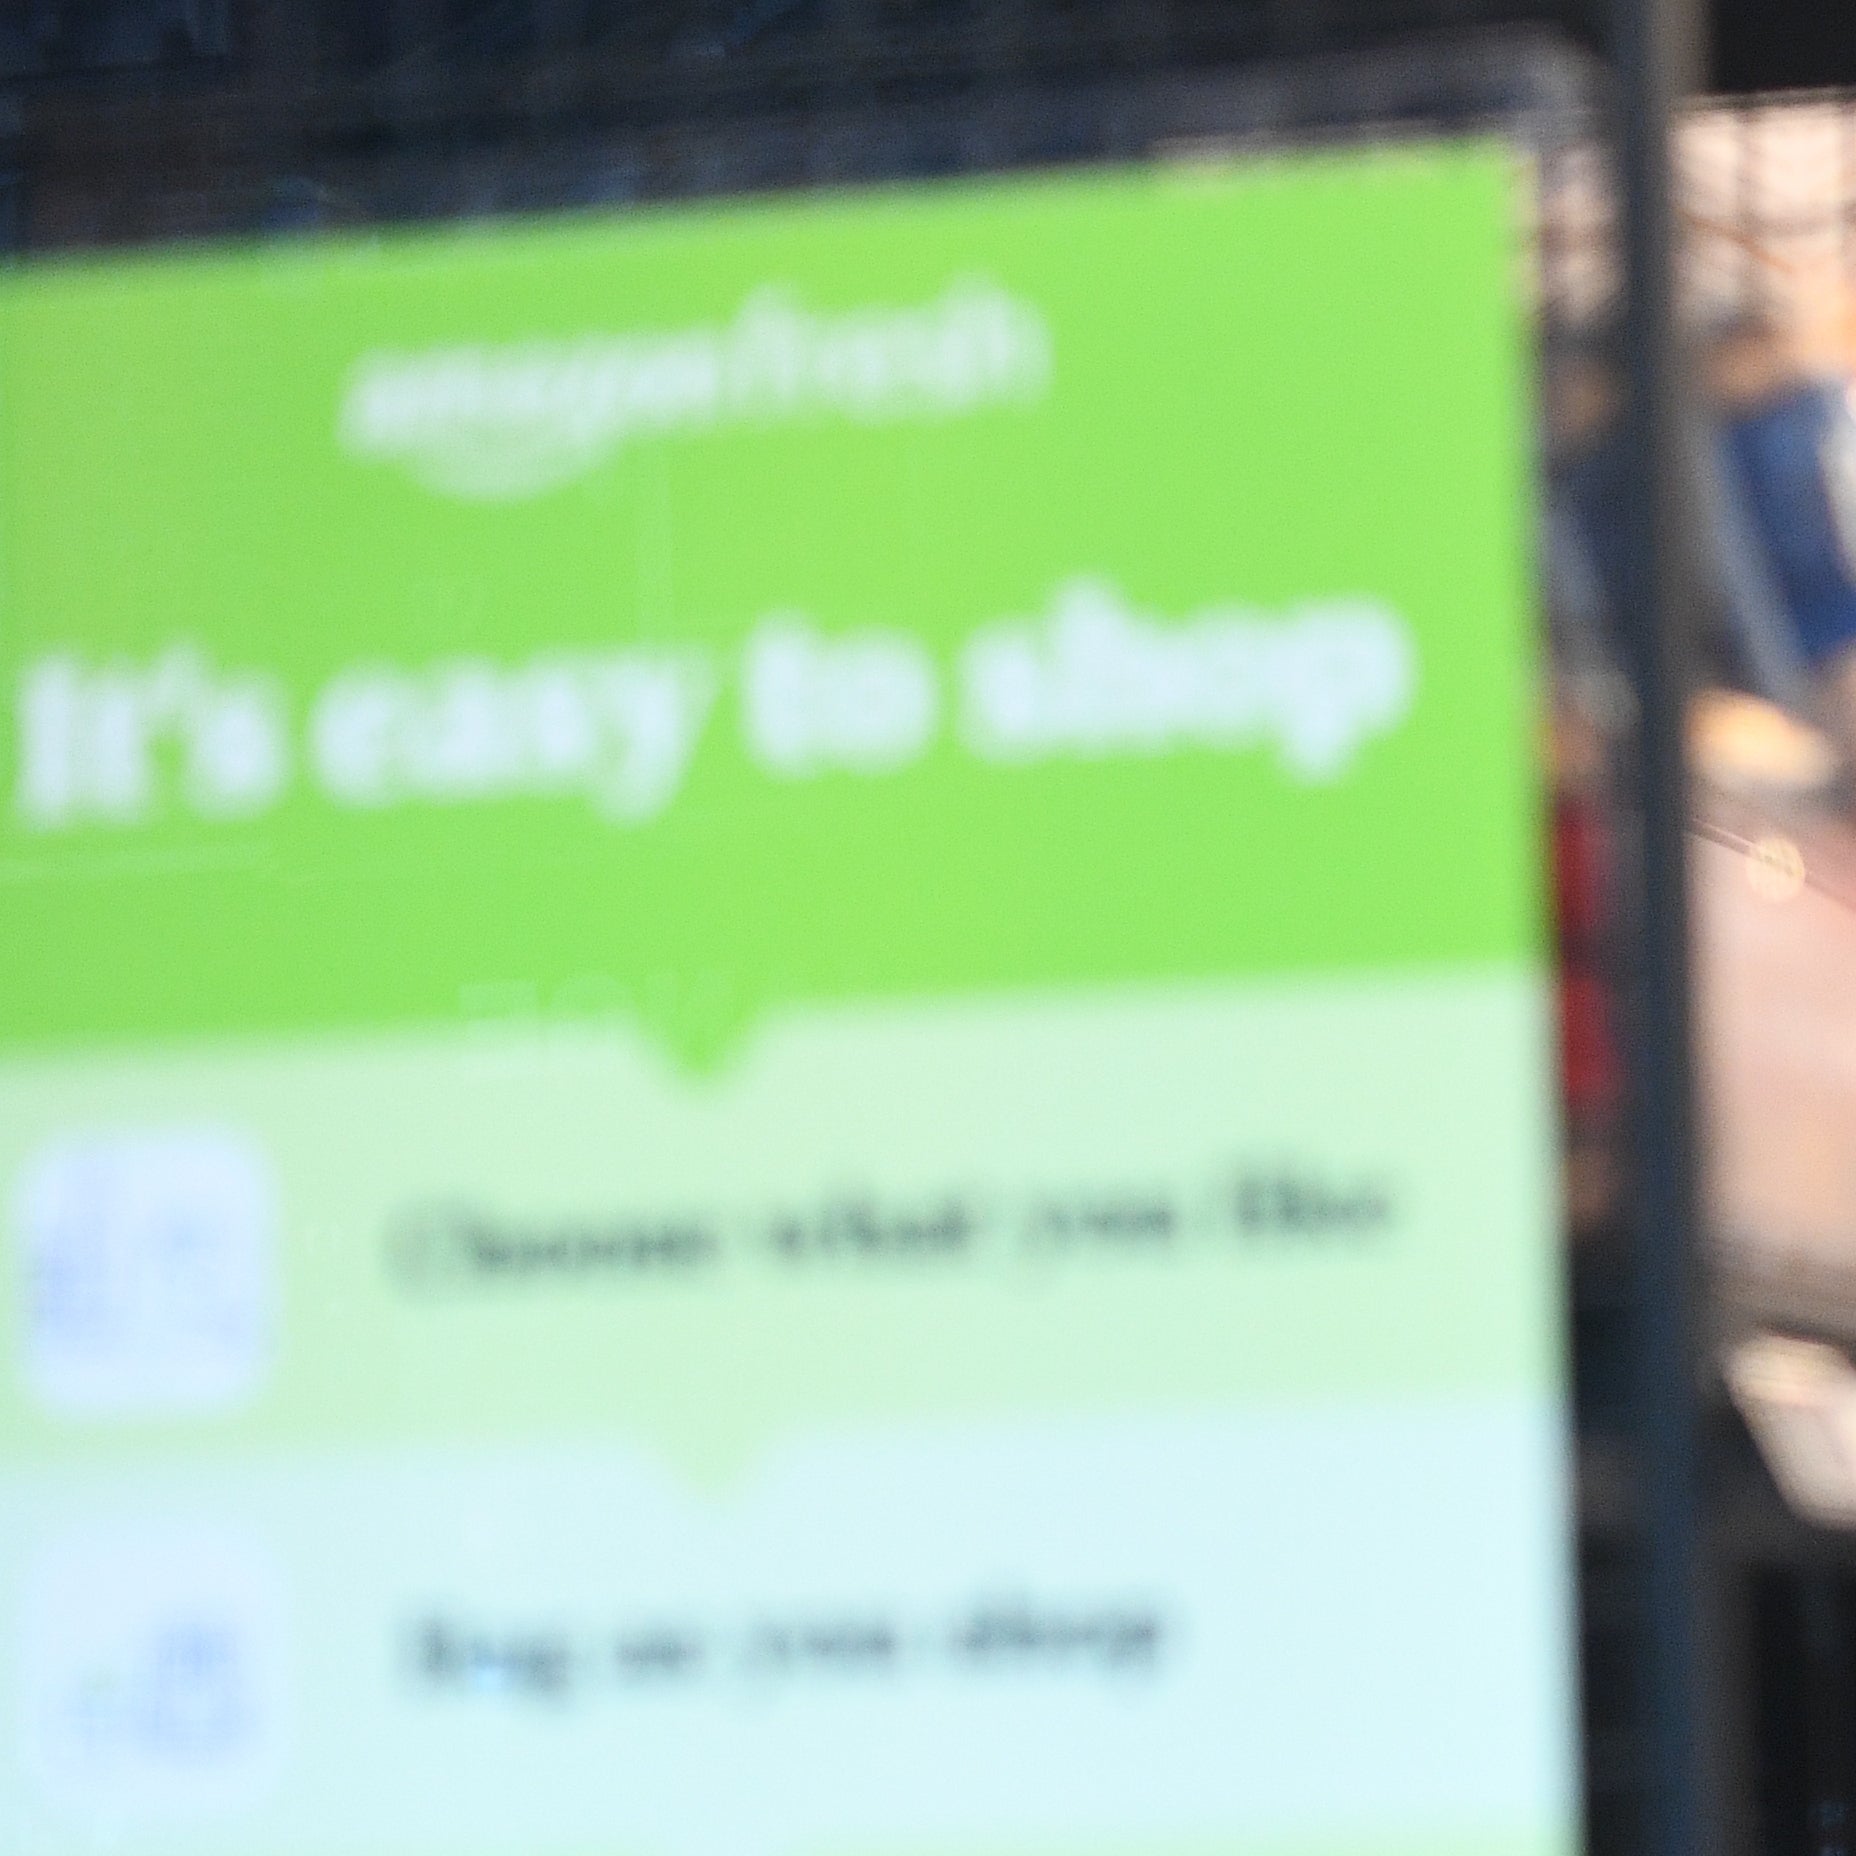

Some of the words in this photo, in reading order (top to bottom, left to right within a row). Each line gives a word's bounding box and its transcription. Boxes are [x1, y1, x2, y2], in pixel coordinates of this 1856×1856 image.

[13, 638, 286, 828] It's
[310, 647, 712, 824] easy
[741, 611, 940, 780] to
[956, 575, 1415, 786] shop
